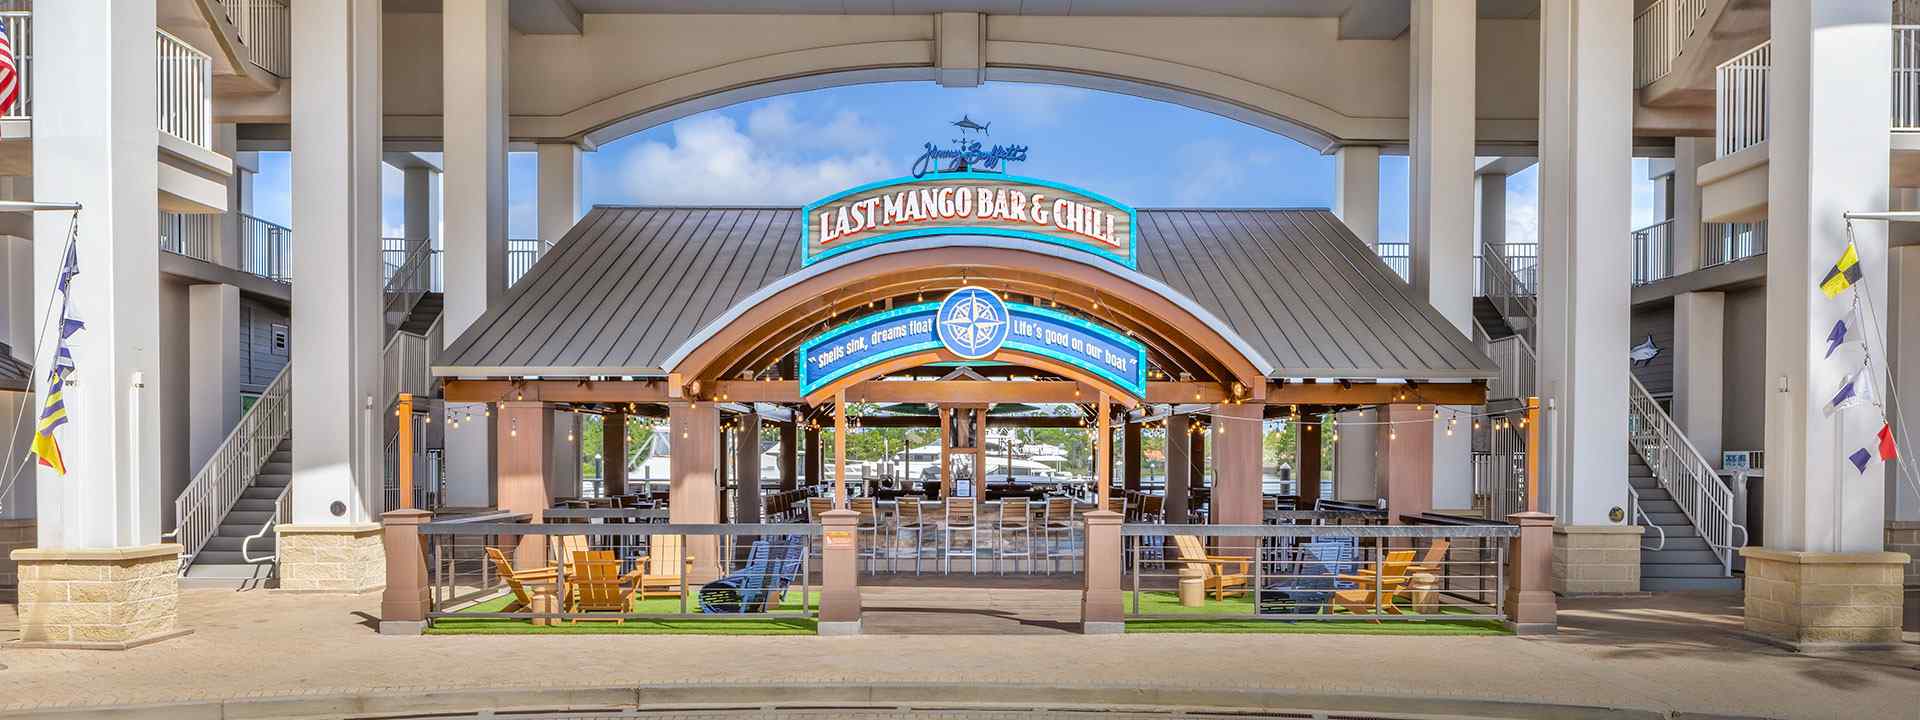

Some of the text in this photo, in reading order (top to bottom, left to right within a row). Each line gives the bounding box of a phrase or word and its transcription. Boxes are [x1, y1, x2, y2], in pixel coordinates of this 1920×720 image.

[820, 187, 1121, 248] LAST MANGO BAR & CHILL
[871, 324, 907, 345] dreams
[909, 318, 933, 335] float
[1045, 328, 1069, 347] good
[1071, 337, 1084, 352] on
[1086, 342, 1103, 359] our
